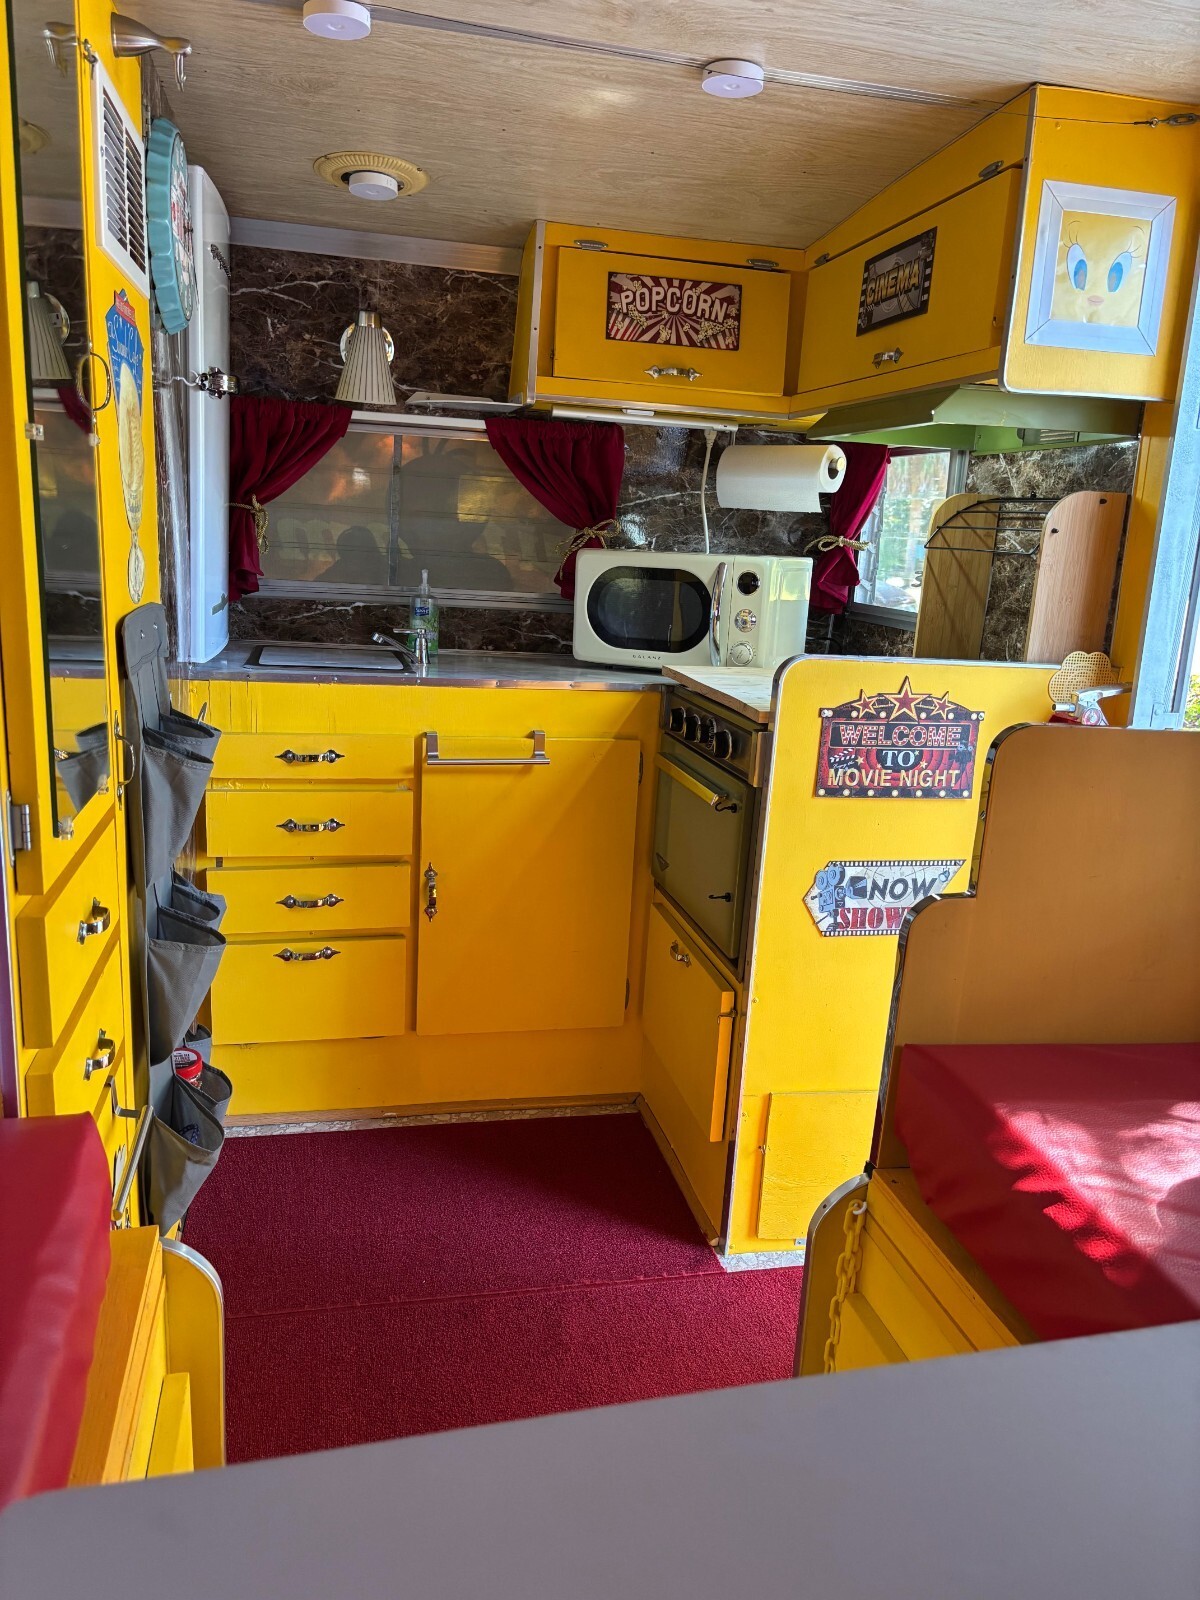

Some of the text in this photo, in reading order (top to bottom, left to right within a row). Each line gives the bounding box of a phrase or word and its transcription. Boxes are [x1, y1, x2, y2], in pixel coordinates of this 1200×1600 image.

[866, 258, 920, 306] CINEMA
[620, 286, 728, 323] POPCORN
[839, 725, 962, 747] WELCOME
[882, 750, 915, 767] TO
[827, 768, 961, 787] MOVIE NIGHT
[868, 878, 938, 901] NOW
[838, 906, 913, 930] SHOW
